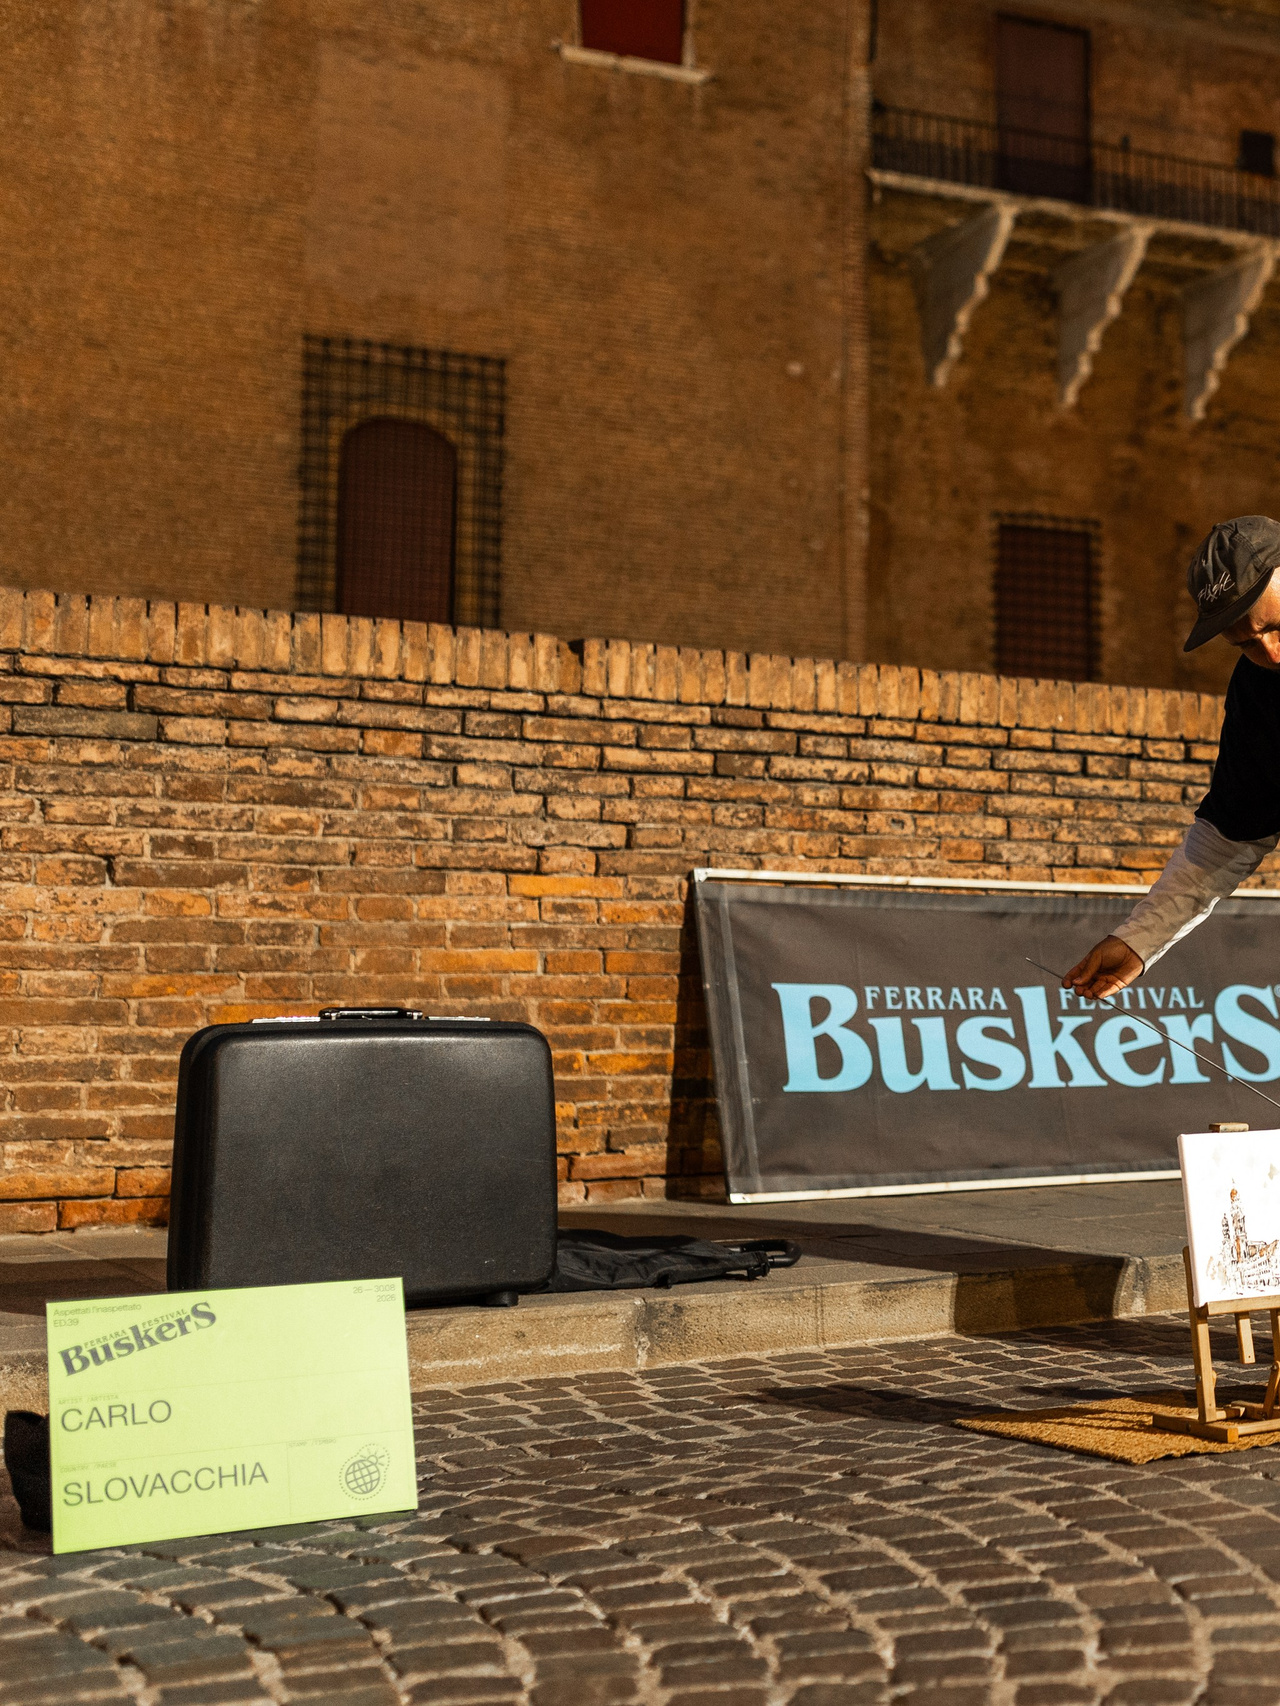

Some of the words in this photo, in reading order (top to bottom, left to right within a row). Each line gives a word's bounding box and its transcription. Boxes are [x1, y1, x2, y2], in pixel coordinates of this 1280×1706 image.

[864, 985, 1009, 1011] FERRARA
[353, 1286, 363, 1294] 26
[376, 1294, 396, 1302] 2026
[84, 1329, 127, 1349] FERRARA
[142, 1308, 188, 1328] FESTIVAL
[61, 1399, 172, 1433] CARLO
[63, 1461, 269, 1507] SLOVACCHIA
